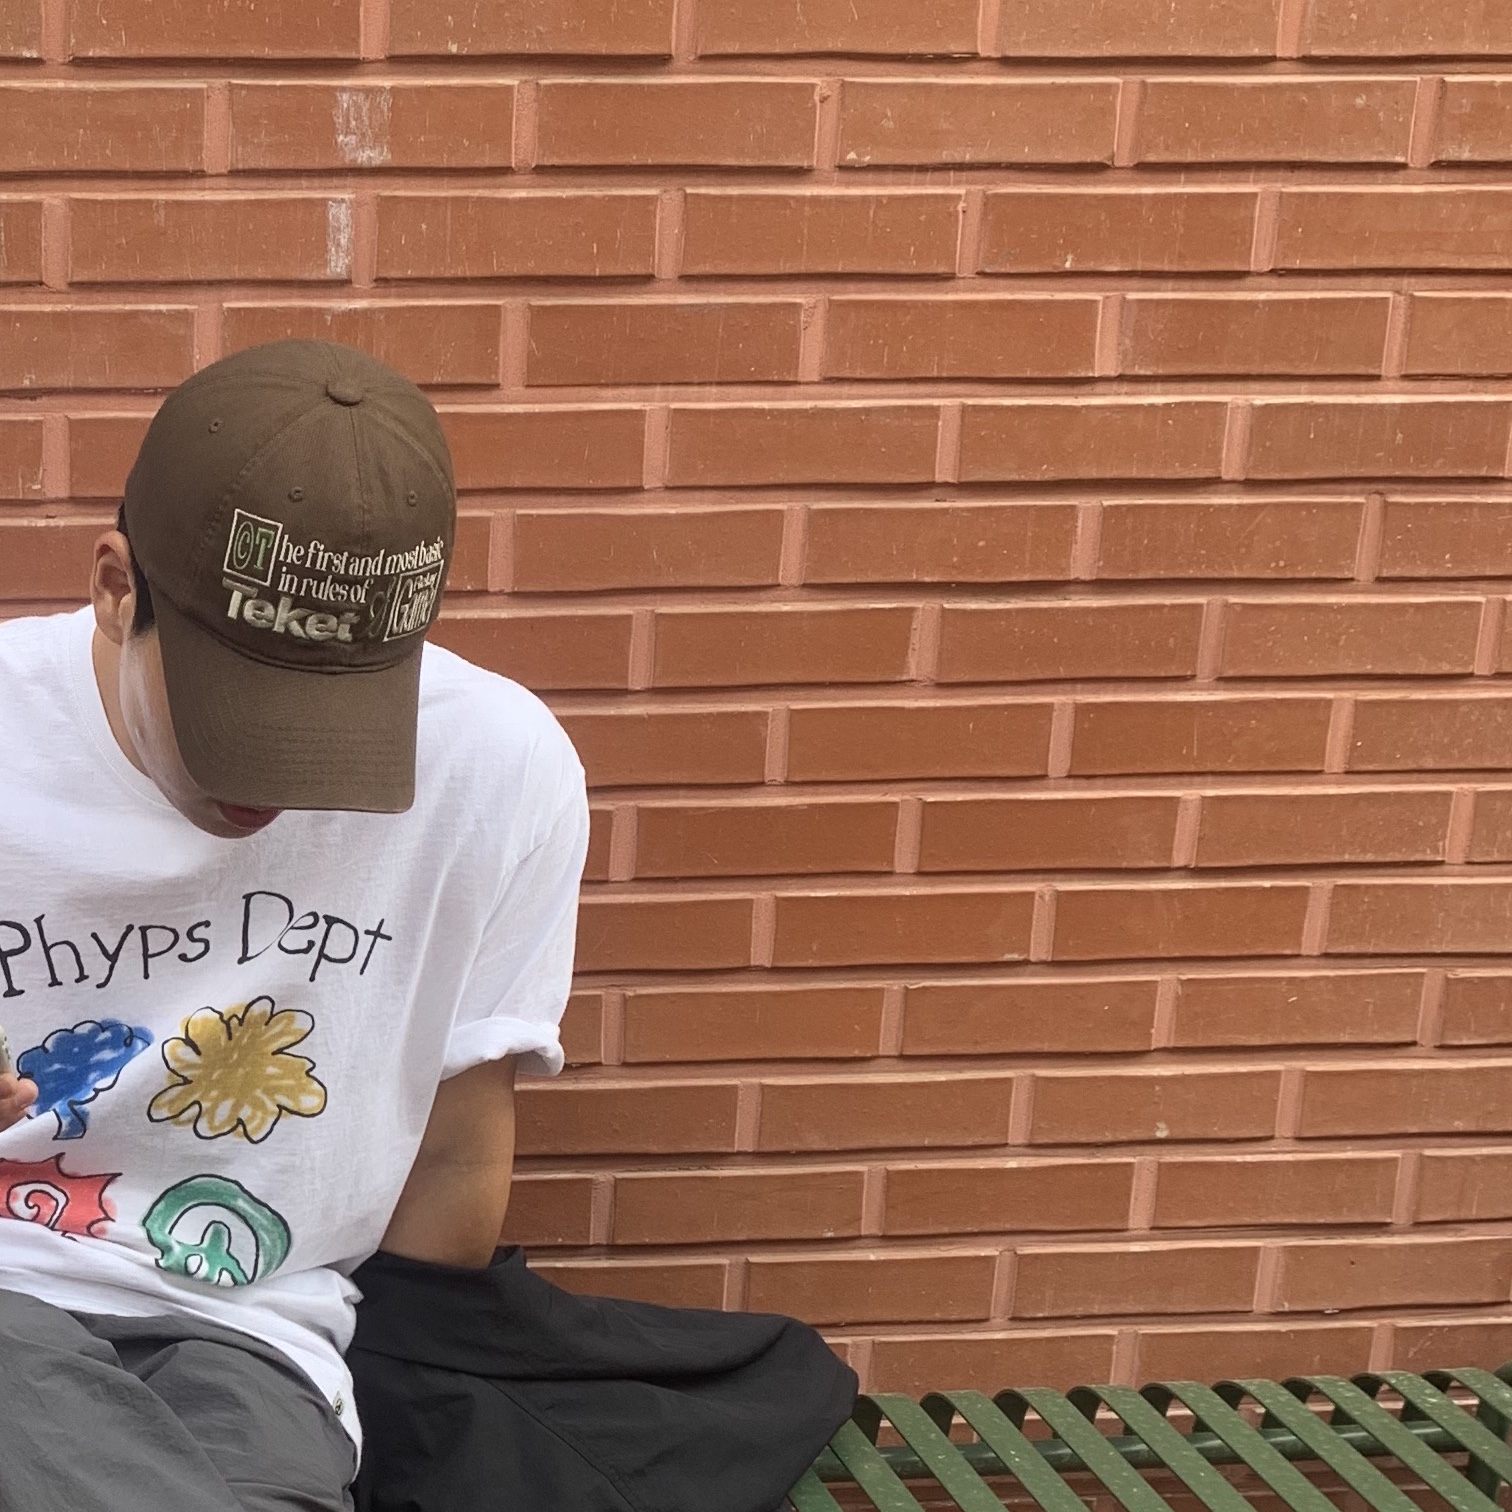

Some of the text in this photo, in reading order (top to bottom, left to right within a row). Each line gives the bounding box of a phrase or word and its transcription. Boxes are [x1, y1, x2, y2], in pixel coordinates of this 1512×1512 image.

[305, 540, 348, 575] first
[348, 548, 385, 577] and
[384, 545, 419, 575] most
[277, 566, 375, 604] in rules of
[237, 890, 393, 983] Dept
